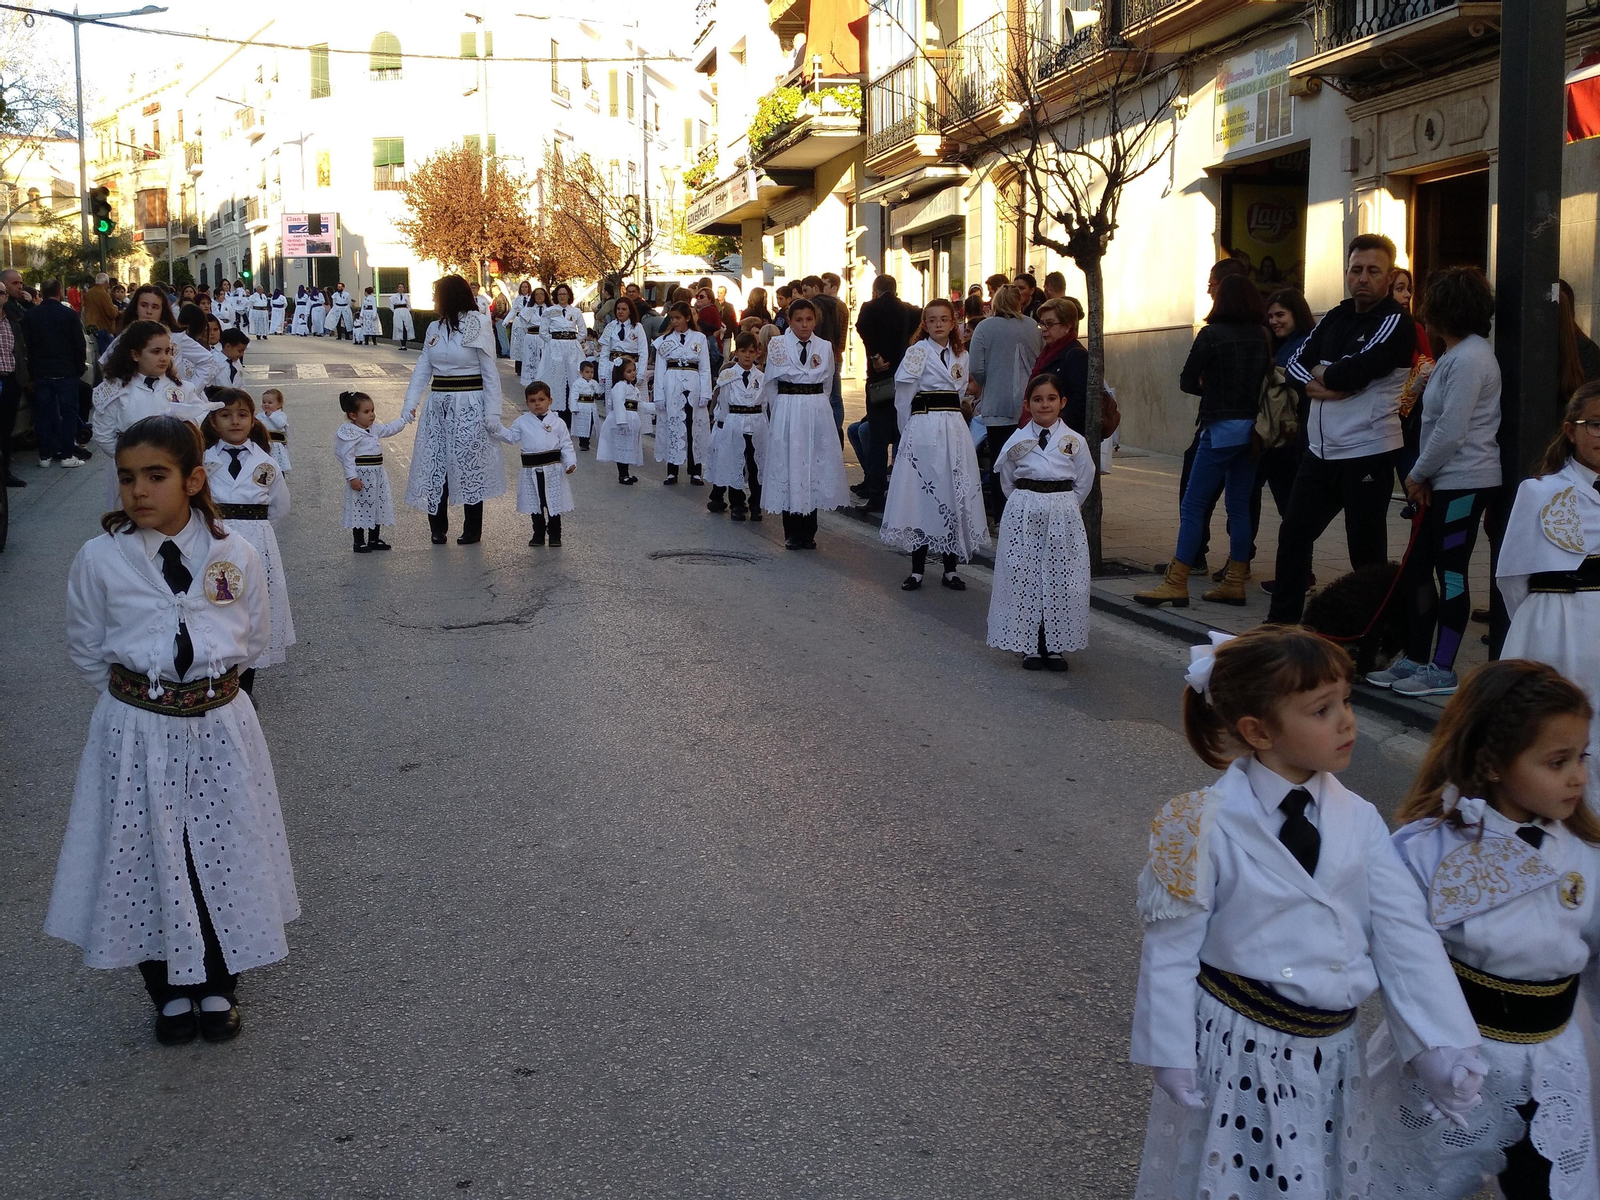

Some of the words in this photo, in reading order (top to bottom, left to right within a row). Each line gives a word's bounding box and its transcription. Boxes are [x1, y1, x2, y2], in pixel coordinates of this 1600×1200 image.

[1255, 43, 1294, 75] Vicente
[1218, 83, 1257, 104] TENEMOS
[928, 192, 952, 216] PASOS
[1250, 203, 1295, 236] Lay's
